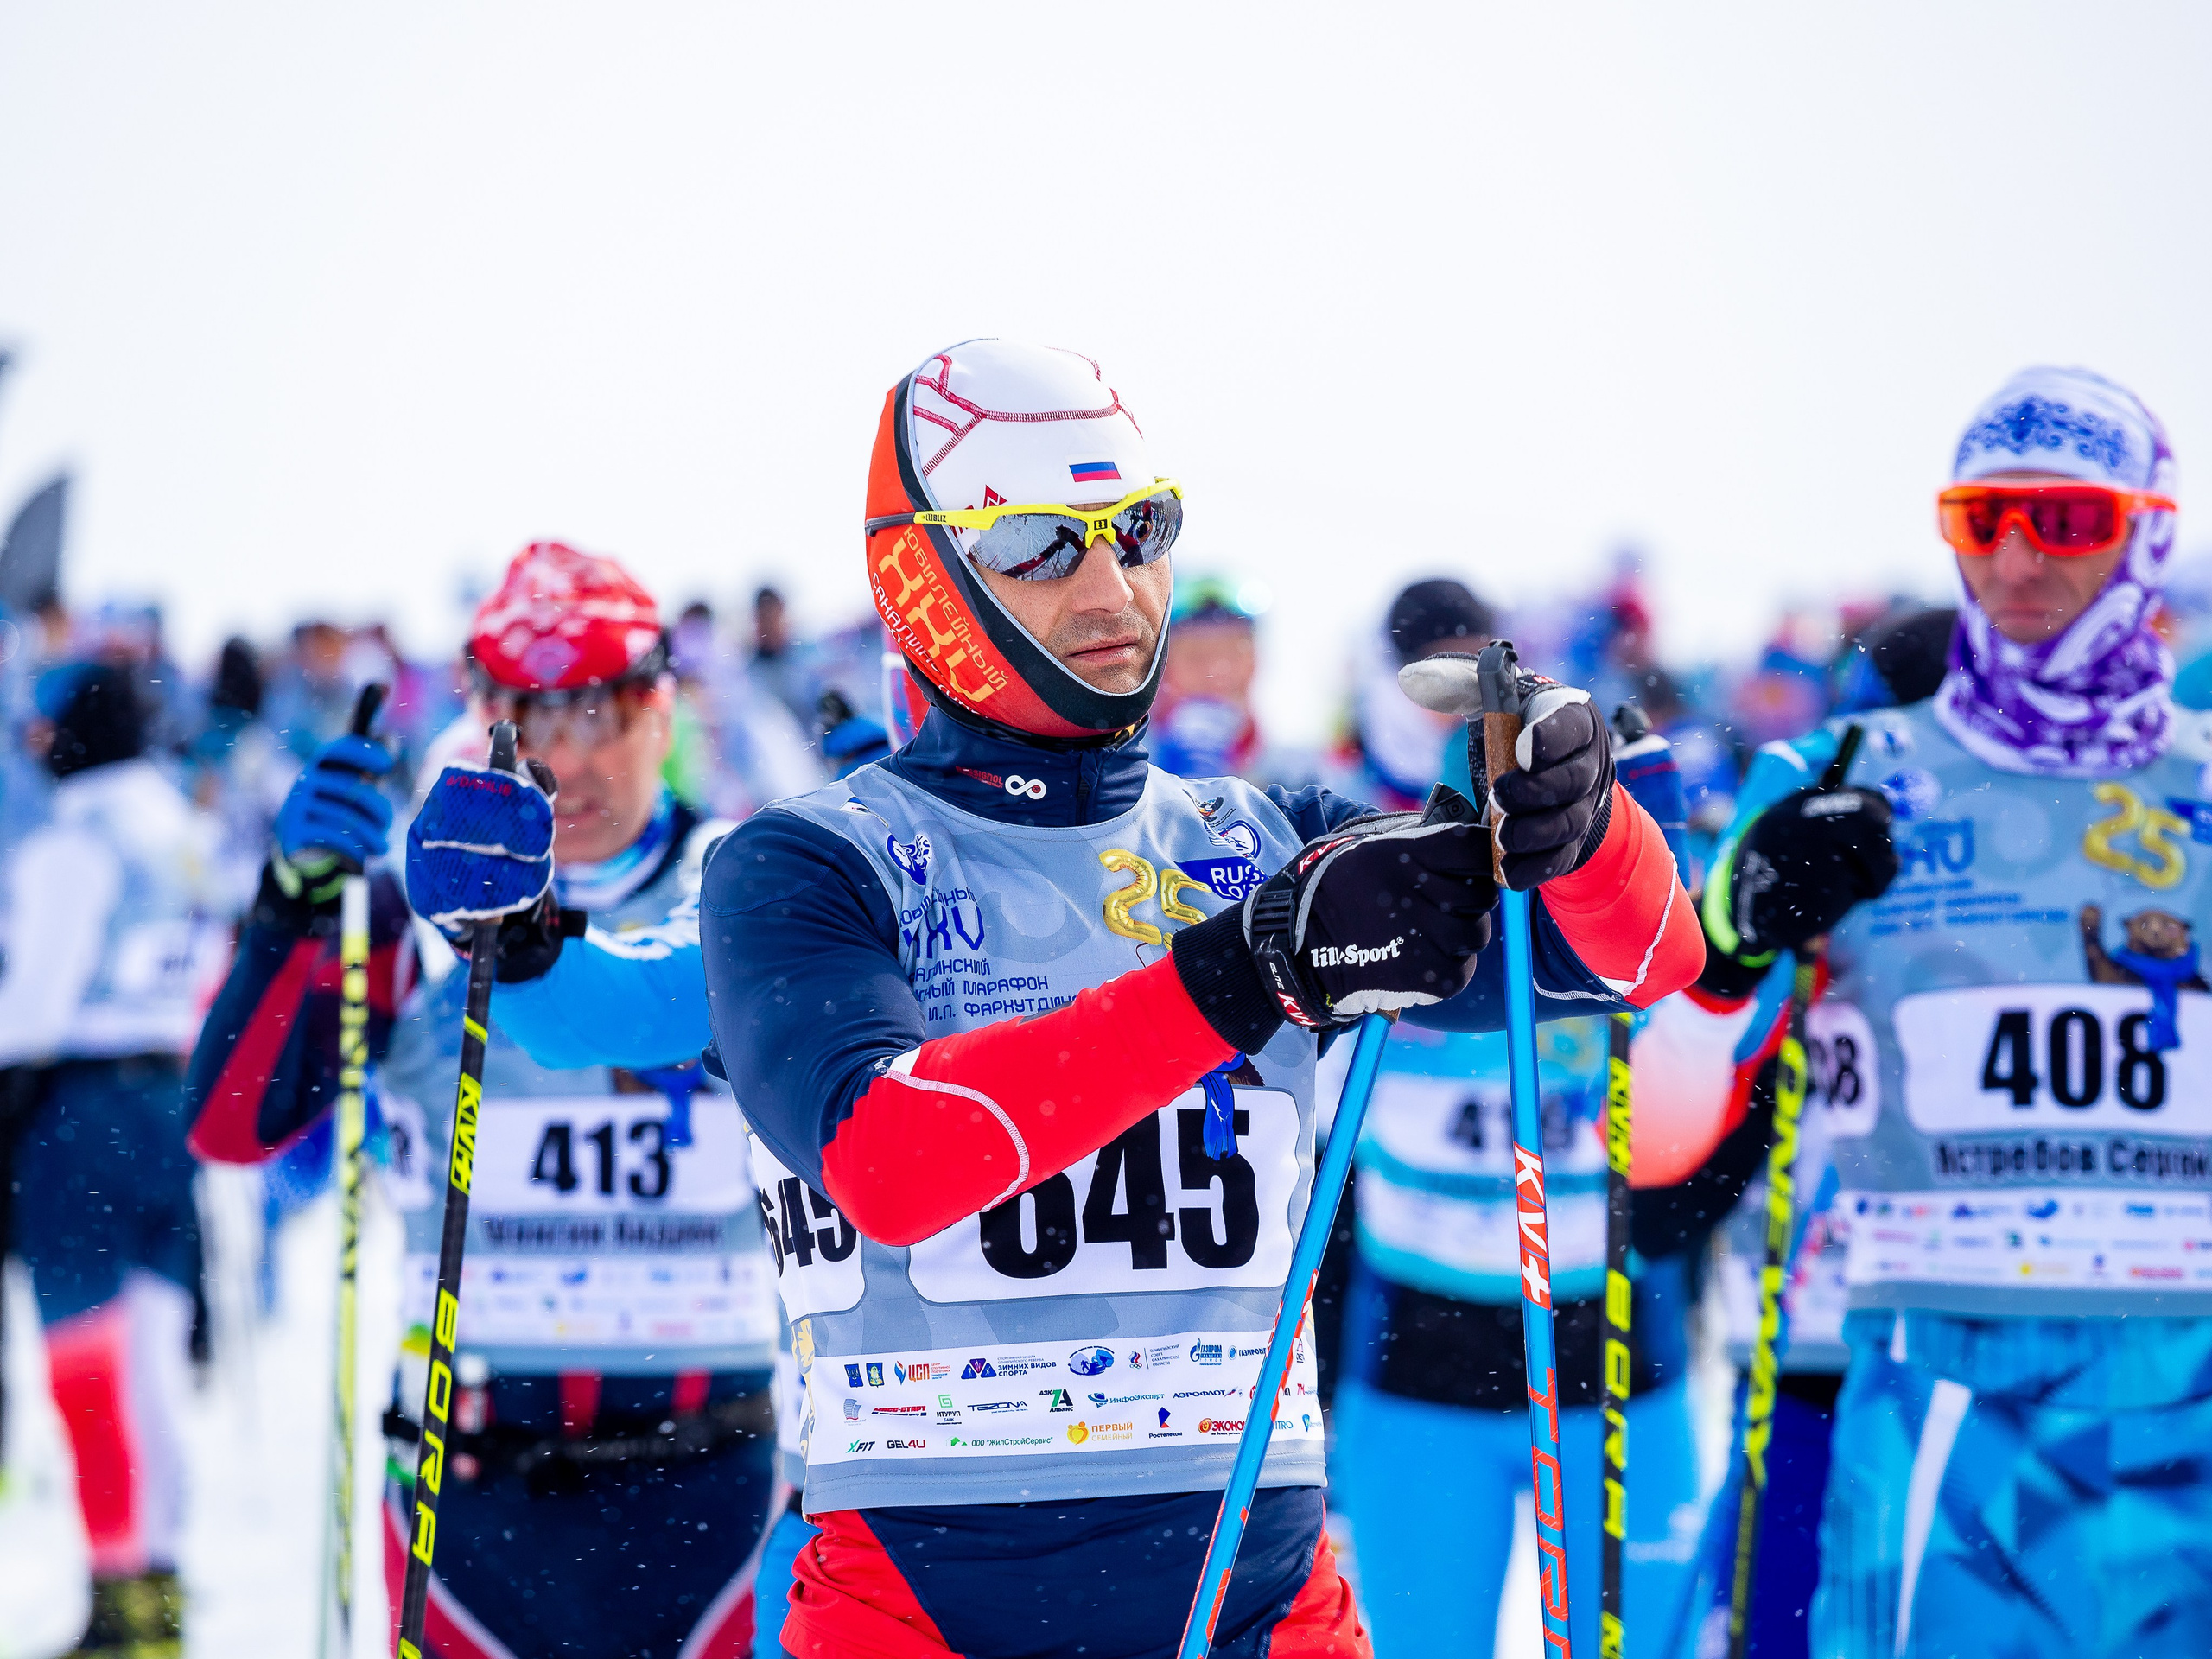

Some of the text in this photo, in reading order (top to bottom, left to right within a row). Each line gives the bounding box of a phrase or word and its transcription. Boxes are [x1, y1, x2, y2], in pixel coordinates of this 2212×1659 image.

[904, 525, 1009, 690] ЮБИЛЕЙНЫЙ
[910, 958, 991, 987] АЛИНСКИЙ
[1269, 961, 1285, 990] ELITE
[963, 976, 1049, 996] МАРАФОН
[928, 1004, 956, 1021] И.П.
[1982, 1007, 2165, 1112] 408
[532, 1122, 673, 1199] 413
[762, 1177, 857, 1279] 645
[1200, 1344, 1222, 1353] ГАЗПРОМ
[909, 1363, 930, 1382] ЦСП
[1109, 1393, 1166, 1404] ИнфоЭксперт
[1173, 1389, 1225, 1399] АЭРОФЛОТ
[1604, 1269, 1632, 1540] BORA
[412, 1287, 459, 1567] BORA
[1091, 1421, 1133, 1433] ПЕРВЫЙ
[1274, 1420, 1294, 1430] ITRO
[845, 1439, 876, 1453] XFIT
[887, 1439, 926, 1449] GEL4U
[1091, 1432, 1133, 1442] СЕМЕЙНЫЙ
